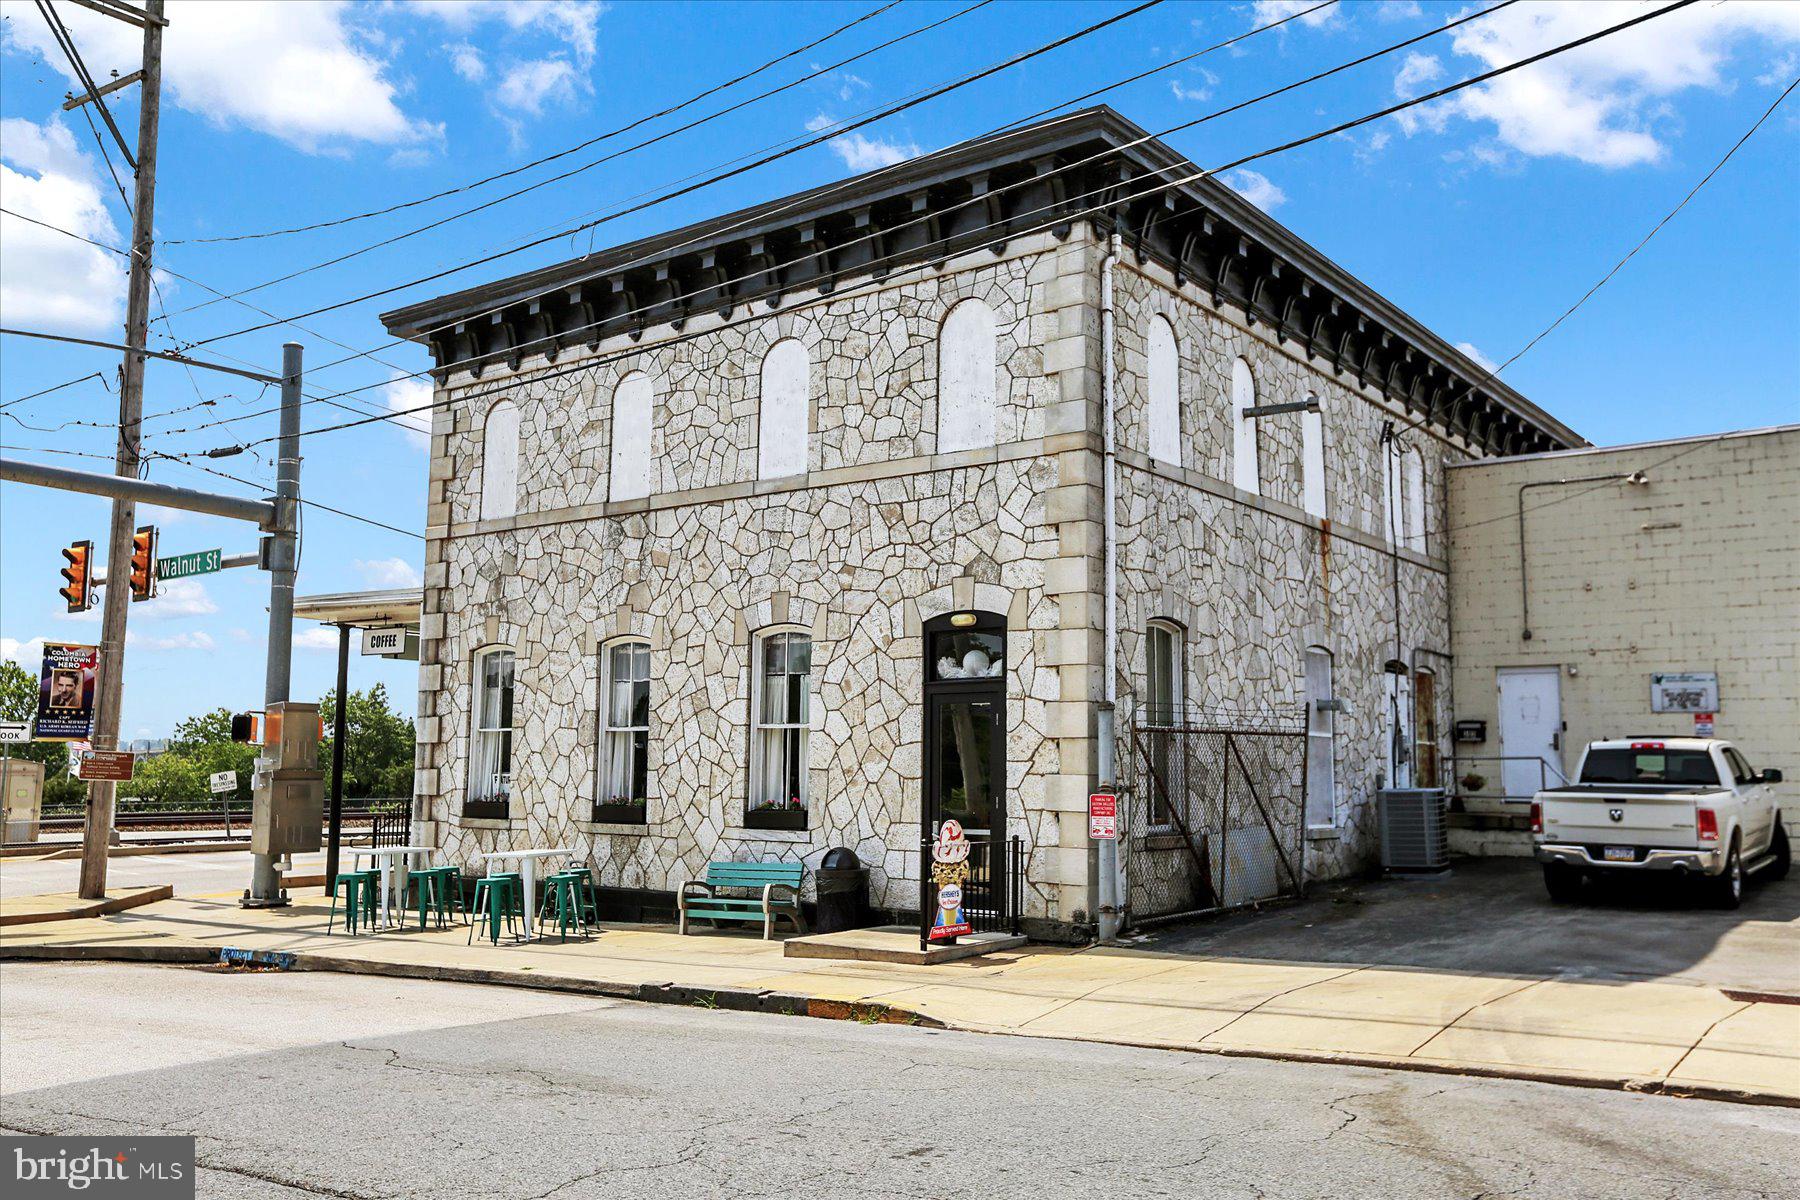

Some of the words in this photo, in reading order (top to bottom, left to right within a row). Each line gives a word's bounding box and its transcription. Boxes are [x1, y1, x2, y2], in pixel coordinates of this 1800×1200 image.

[160, 554, 200, 577] Walnut
[206, 551, 217, 570] St
[371, 635, 396, 648] COFFEE
[47, 655, 91, 664] HOMETOWN
[218, 773, 228, 781] NO
